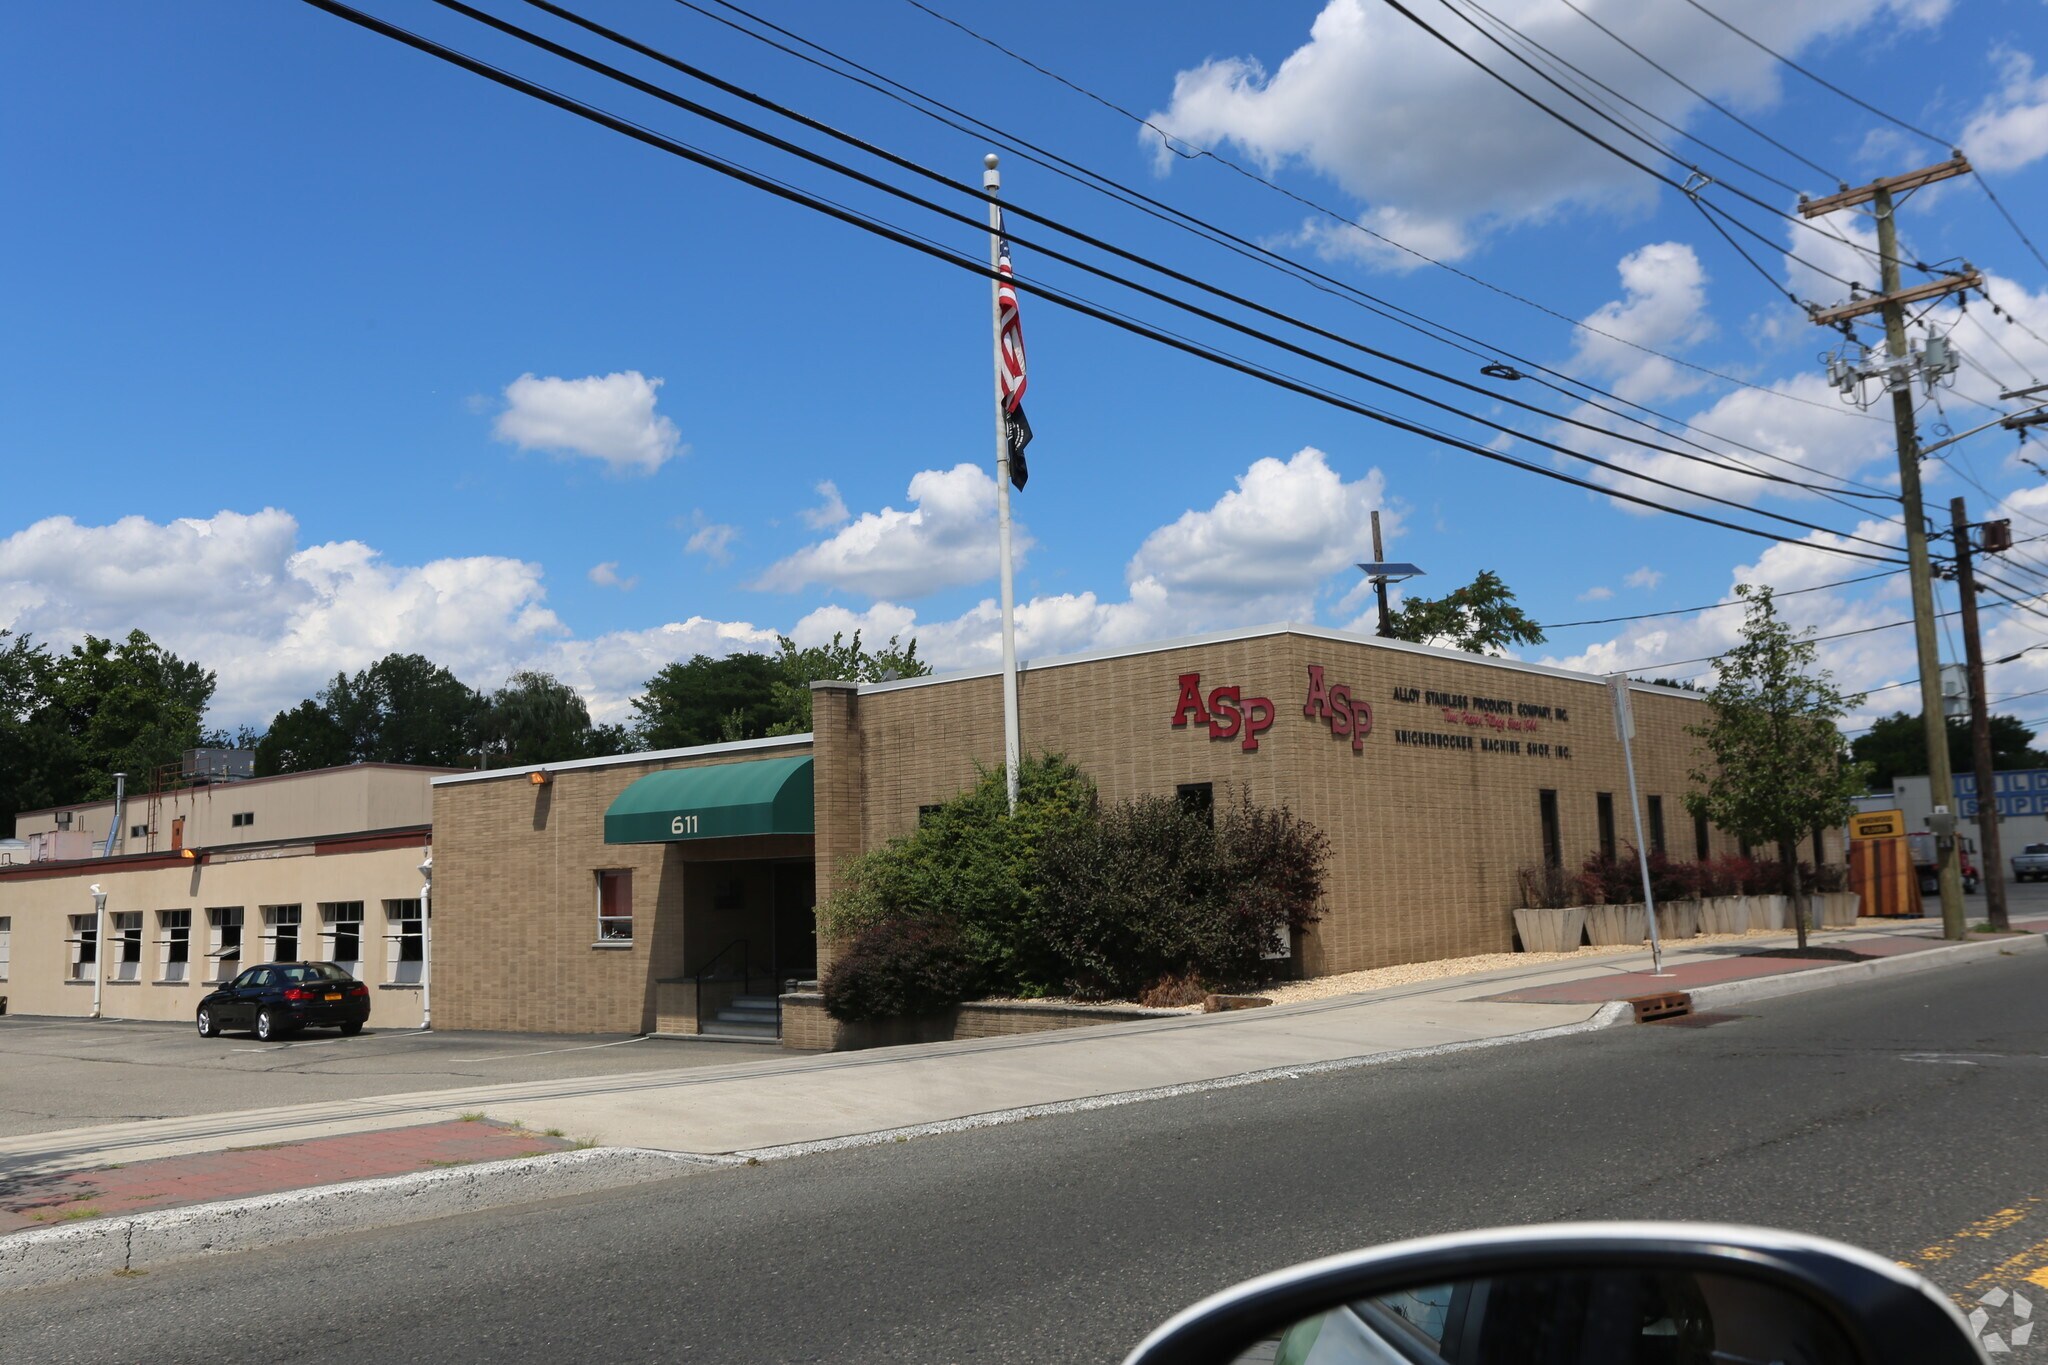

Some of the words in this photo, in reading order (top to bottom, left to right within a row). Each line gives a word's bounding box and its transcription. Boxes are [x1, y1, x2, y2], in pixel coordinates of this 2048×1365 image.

[1171, 673, 1275, 750] ASP
[1304, 664, 1372, 750] ASP
[1393, 687, 1420, 703] ALLOY
[1425, 691, 1468, 709] STAINLESS
[1473, 697, 1512, 715] PRODUCTS
[1395, 730, 1473, 750] KNICKERBOCKER
[1481, 738, 1520, 754] MACHINE
[671, 815, 698, 834] 611
